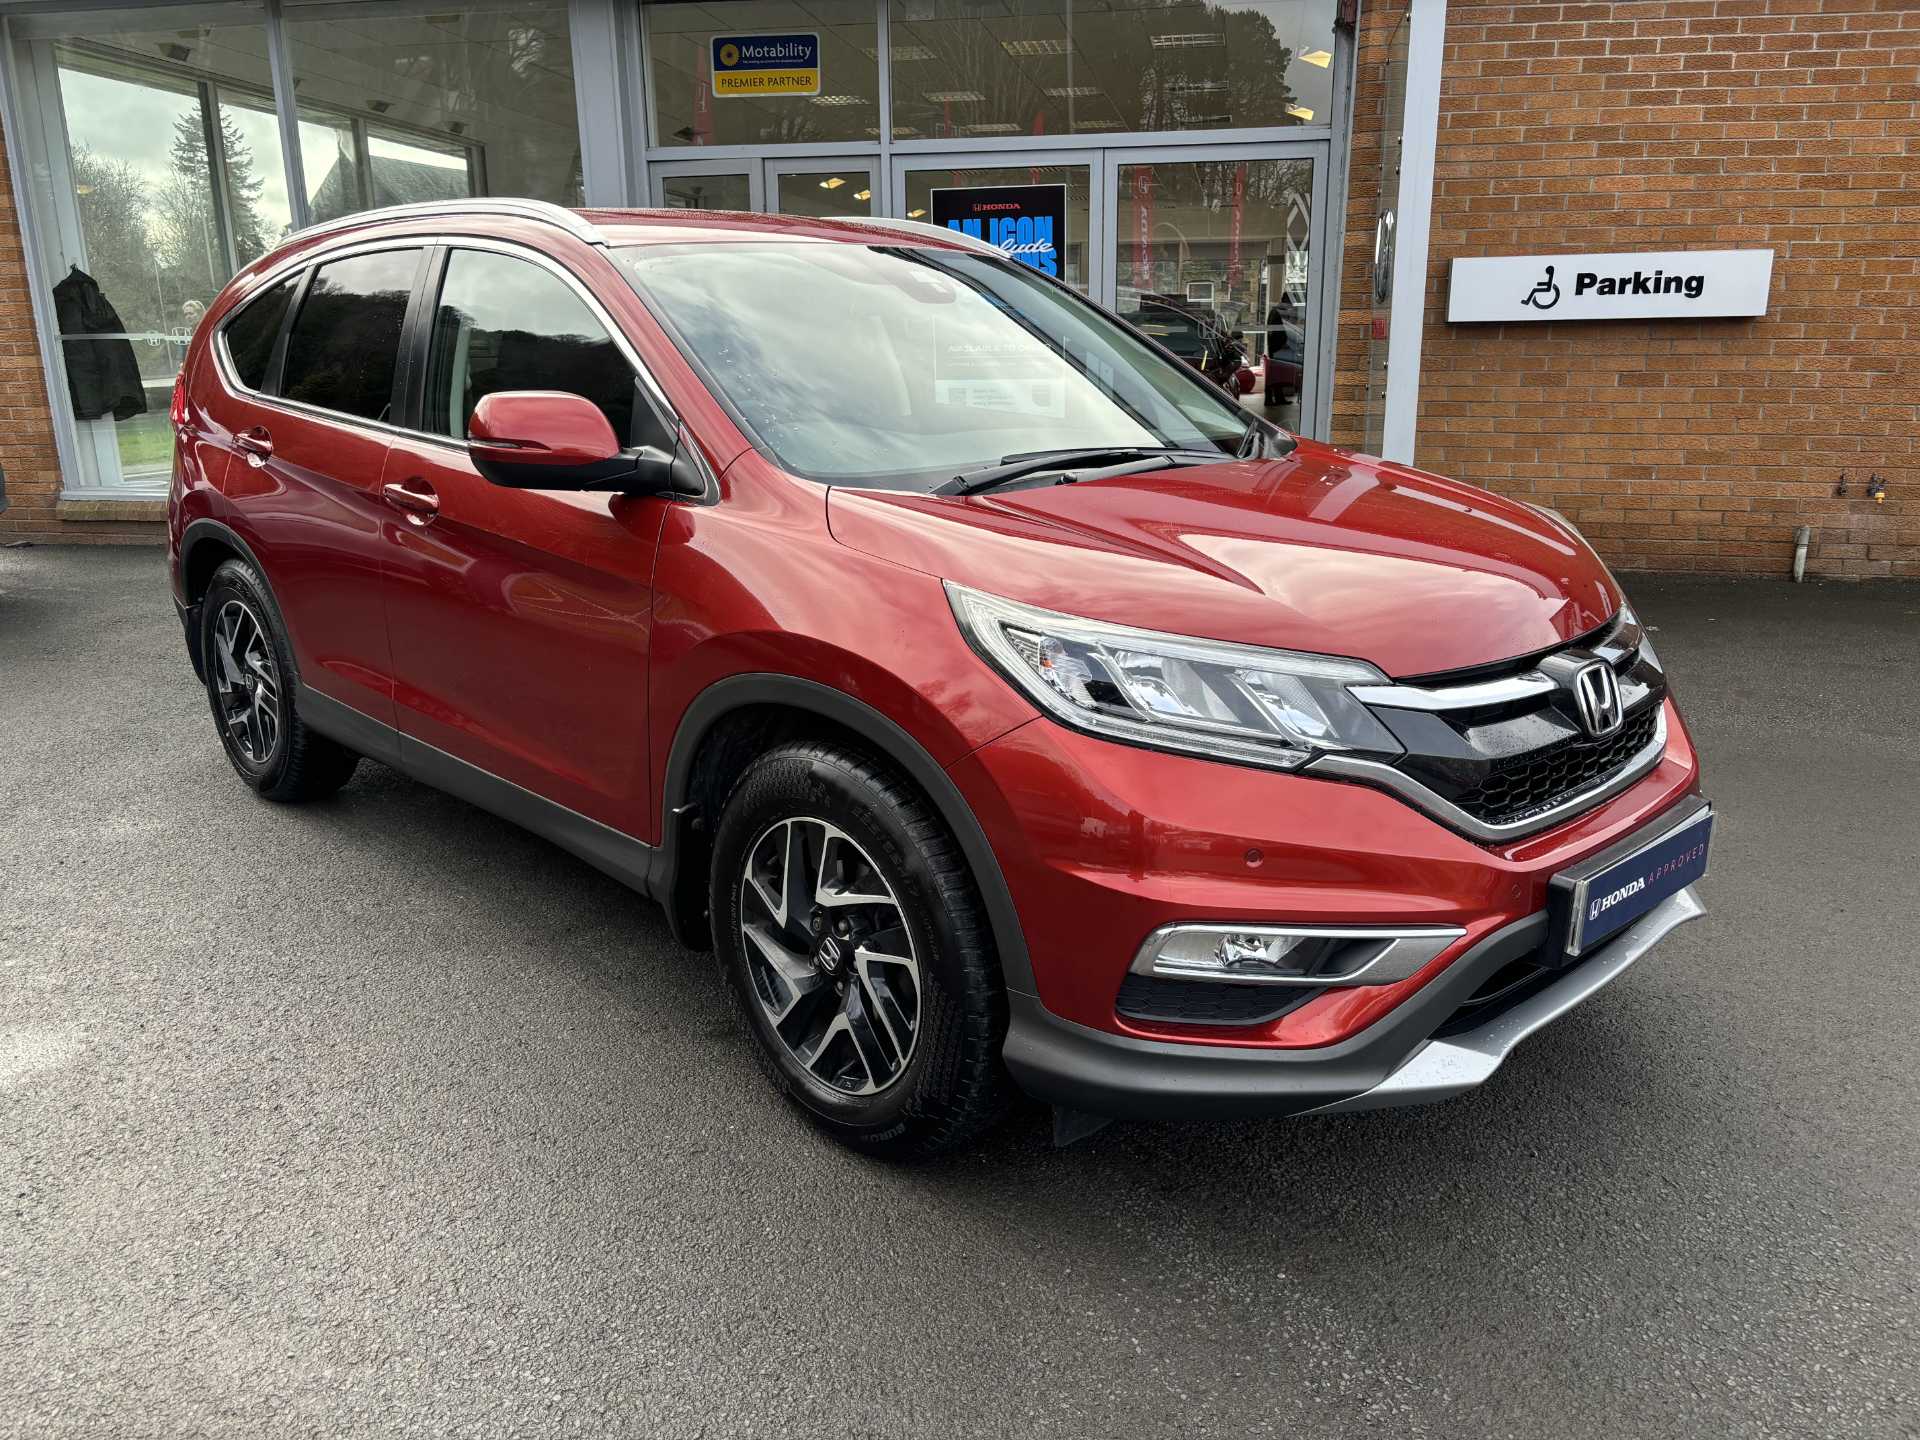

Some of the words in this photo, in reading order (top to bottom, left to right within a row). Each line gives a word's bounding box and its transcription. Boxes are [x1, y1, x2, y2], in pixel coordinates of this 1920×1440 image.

[741, 42, 812, 60] Motability
[721, 77, 765, 88] PREMIER
[767, 75, 812, 87] PARTNER
[982, 203, 1021, 211] HONDA
[989, 215, 1054, 249] ICON
[1575, 270, 1704, 298] Parking
[1600, 876, 1646, 912] HONDA
[1648, 843, 1704, 885] APPROVED
